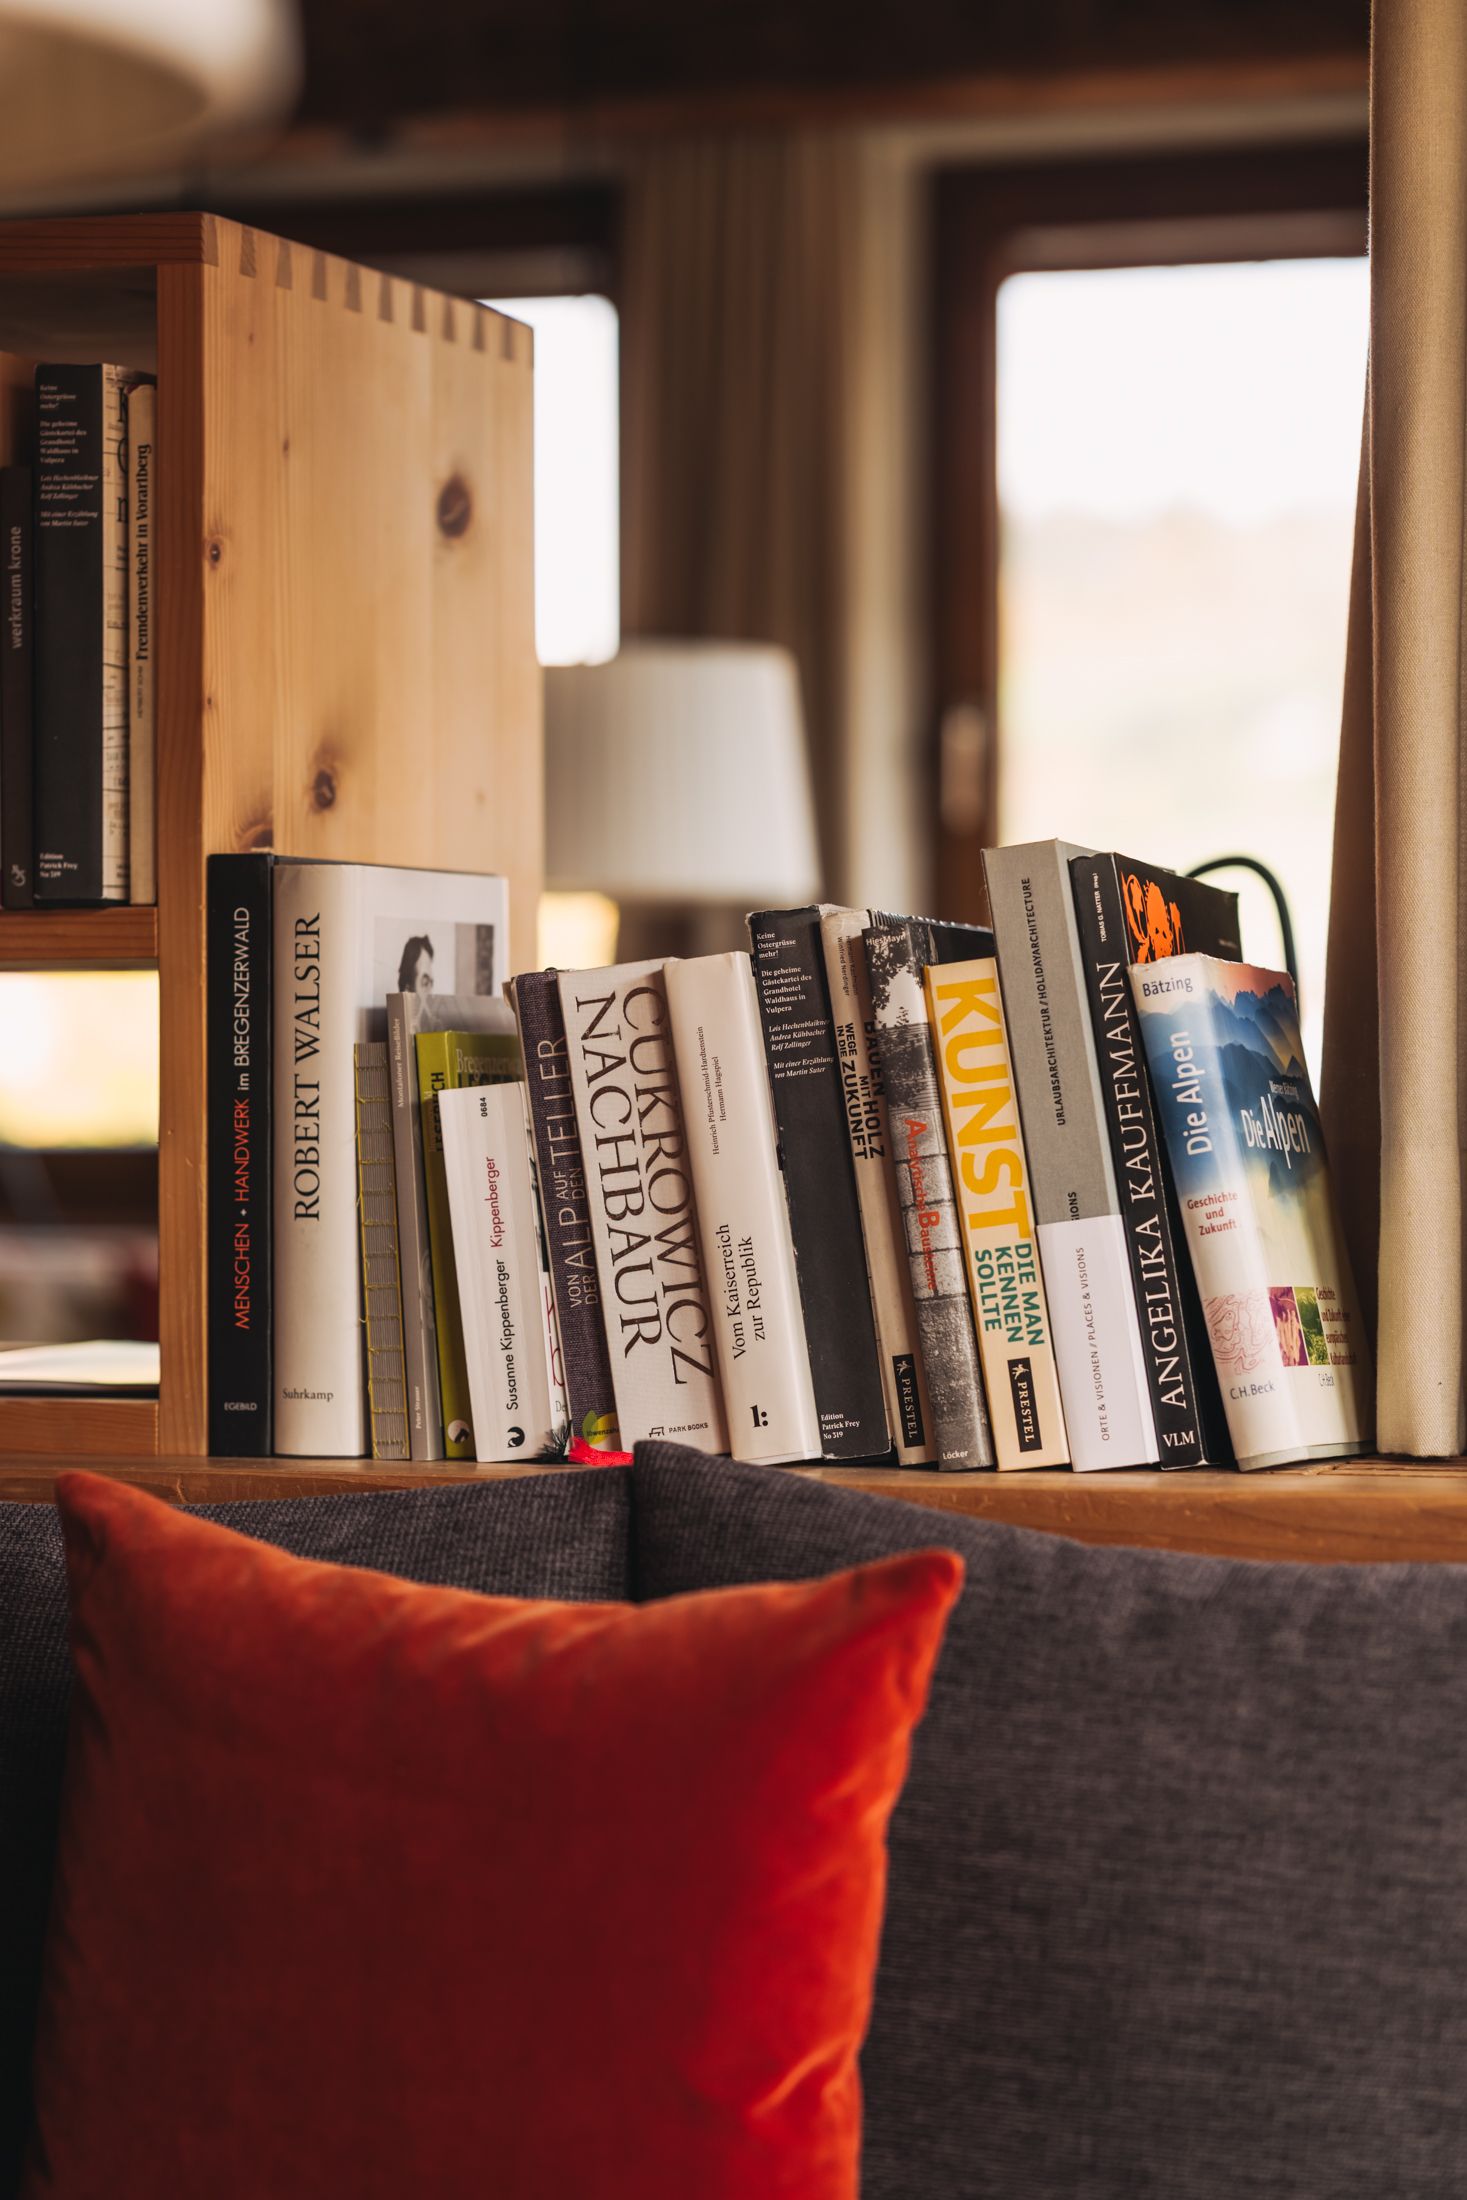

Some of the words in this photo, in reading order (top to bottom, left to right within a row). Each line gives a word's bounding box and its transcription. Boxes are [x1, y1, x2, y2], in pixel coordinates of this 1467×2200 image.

[136, 443, 151, 520] Vorarlberg
[8, 526, 21, 569] krone
[136, 523, 148, 538] in
[8, 574, 22, 648] werkraum
[136, 538, 149, 661] Fremdenverkehr
[1094, 890, 1102, 913] NATTER
[757, 932, 776, 940] Keine
[758, 940, 797, 949] Ostergrüsse
[1021, 877, 1047, 1000] HOLIDAYARCHITECTURE
[1099, 921, 1107, 942] TOBIAS
[759, 950, 779, 959] mehr!
[774, 967, 801, 976] geheime
[234, 907, 249, 1066] BREGENZERWALD
[294, 913, 320, 1065] WALSER
[762, 976, 800, 987] Gästekartei
[763, 985, 801, 996] Grandhotel
[765, 995, 798, 1004] Waldhaus
[1142, 977, 1194, 997] Bätzing
[766, 1005, 792, 1014] Vulpera
[770, 1033, 791, 1042] Andrea
[792, 1029, 826, 1039] Kühbacher
[784, 1040, 812, 1049] Zollinger
[836, 1025, 845, 1037] IN
[839, 1039, 847, 1057] DIE
[845, 1022, 857, 1056] WEGE
[773, 1061, 785, 1069] Mit
[785, 1059, 801, 1067] einer
[802, 1056, 834, 1066] Erzählung
[786, 1068, 808, 1077] Martin
[809, 1066, 826, 1074] Suter
[864, 1021, 885, 1097] BAUEN
[1040, 1007, 1066, 1127] URLAUBSARCHITEKTUR
[1170, 1031, 1206, 1104] Alpen
[237, 1073, 249, 1091] im
[538, 1035, 581, 1166] TELLER
[859, 1075, 871, 1098] MIT
[1096, 962, 1156, 1204] KAUFFMANN
[480, 1097, 488, 1117] 0684
[717, 1089, 727, 1121] Hermann
[841, 1060, 868, 1160] ZUKUNFT
[936, 978, 1032, 1239] KUNST
[294, 1074, 320, 1221] ROBERT
[709, 1124, 720, 1155] Heinrich
[863, 1100, 885, 1158] HOLZ
[1183, 1111, 1214, 1156] Die
[1240, 1109, 1266, 1149] Die
[1260, 1093, 1311, 1170] Alpen
[235, 1099, 250, 1201] HANDWERK
[554, 1171, 570, 1200] AUF
[569, 1168, 584, 1200] DEN
[575, 991, 662, 1359] NACHBAUR
[623, 987, 715, 1385] CUKROWICZ
[485, 1157, 505, 1248] Kippenberger
[904, 1119, 928, 1211] Analytische
[918, 1211, 940, 1291] Bausteine
[1187, 1191, 1239, 1209] Geschichte
[1205, 1207, 1224, 1220] und
[559, 1206, 595, 1270] ALP
[1198, 1220, 1237, 1236] Zukunft
[235, 1223, 250, 1329] MENSCHEN
[716, 1224, 741, 1318] Kaiserreich
[738, 1236, 762, 1309] Republik
[1015, 1243, 1036, 1284] DIE
[1076, 1247, 1090, 1290] VISIONS
[495, 1260, 515, 1350] Kippenberger
[567, 1274, 582, 1308] VON
[581, 1272, 598, 1304] DER
[975, 1249, 1002, 1331] SOLLTE
[995, 1246, 1024, 1343] KENNEN
[1081, 1291, 1090, 1301] &
[752, 1315, 765, 1341] zur
[1022, 1291, 1045, 1345] MAN
[1083, 1303, 1096, 1341] PLACES
[1135, 1214, 1187, 1409] ANGELIKA
[733, 1322, 746, 1360] Vom
[506, 1354, 518, 1410] Susanne
[1091, 1350, 1104, 1400] VISIONEN
[1229, 1380, 1276, 1400] C.H.Beck
[282, 1388, 334, 1402] Suhrkamp
[902, 1379, 918, 1438] PRESTEL
[1017, 1382, 1035, 1443] PRESTEL
[1098, 1403, 1106, 1412] &
[668, 1425, 686, 1434] PARK
[687, 1422, 709, 1432] BOOKS
[821, 1412, 844, 1421] Edition
[822, 1421, 844, 1430] Patrick
[845, 1420, 860, 1428] Frey
[1100, 1413, 1110, 1441] ORTE
[942, 1449, 969, 1460] Löcker
[1162, 1430, 1196, 1447] VLM
